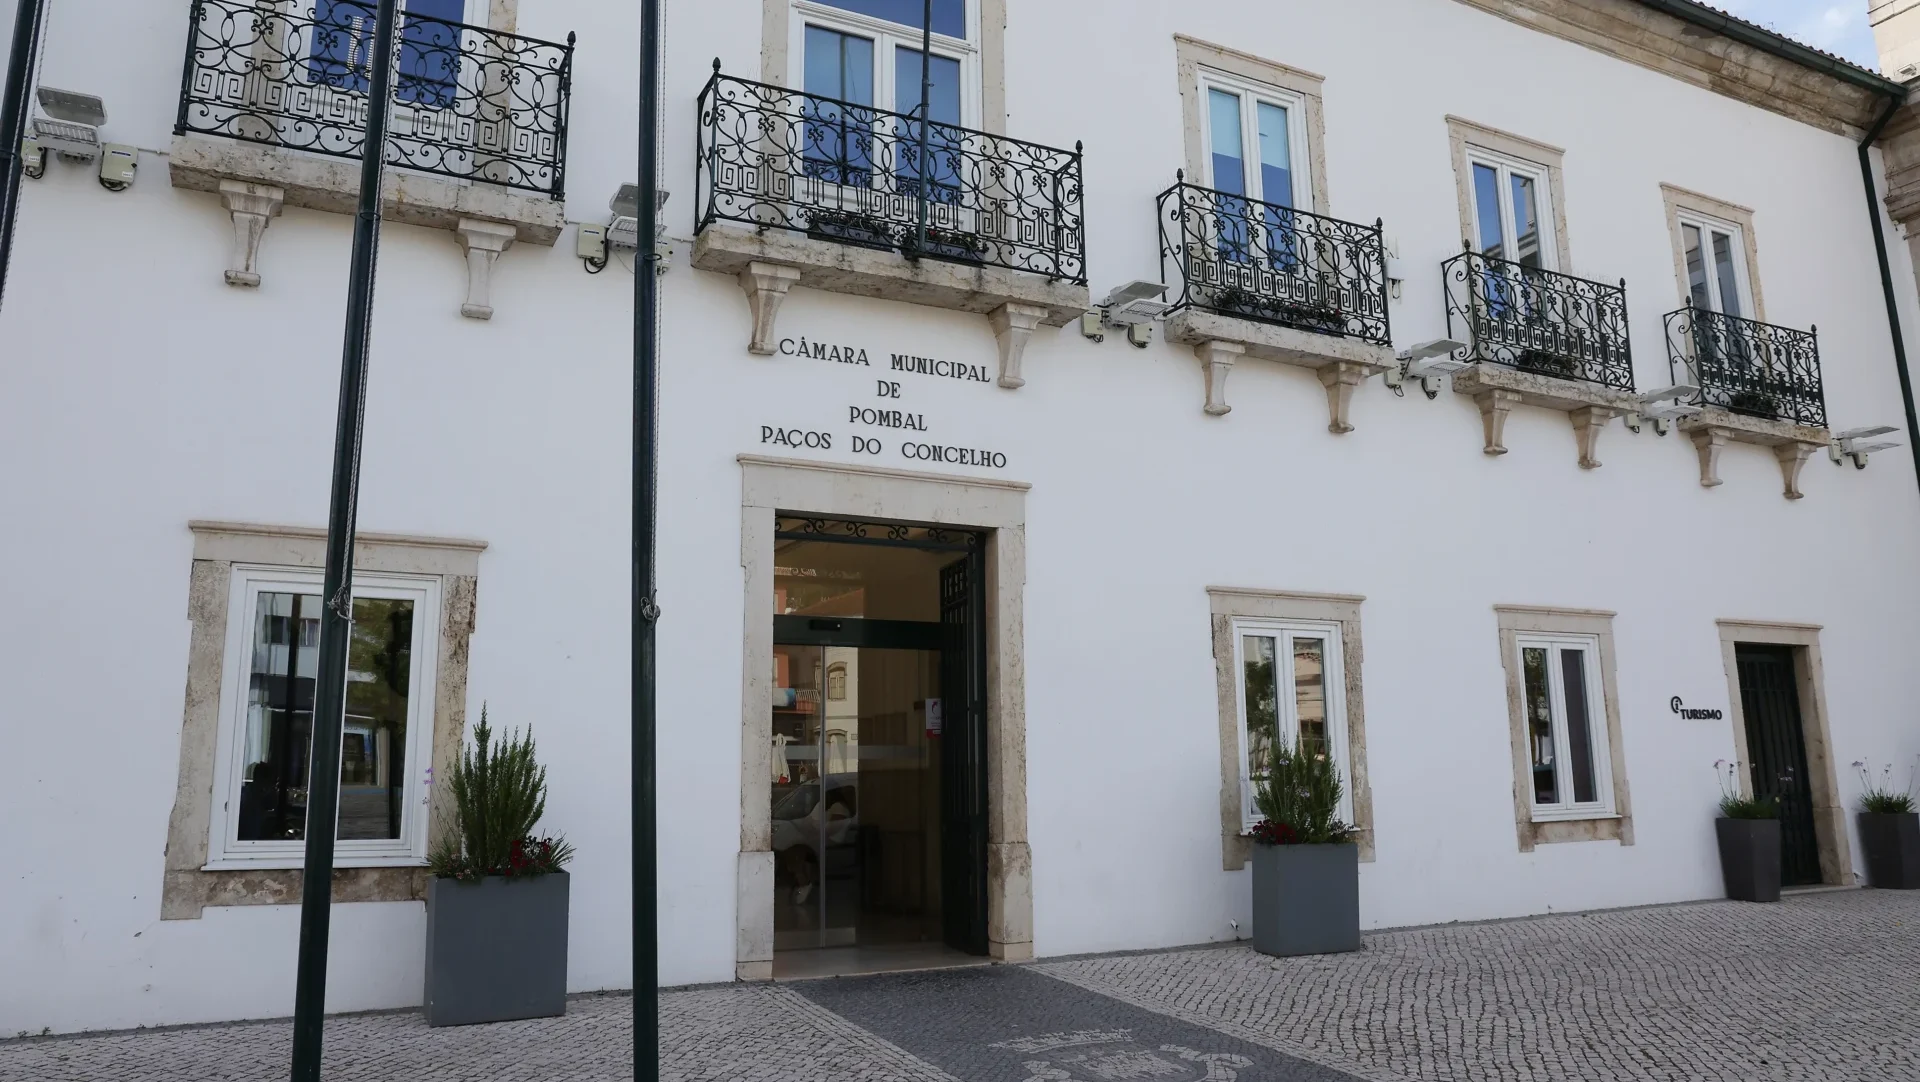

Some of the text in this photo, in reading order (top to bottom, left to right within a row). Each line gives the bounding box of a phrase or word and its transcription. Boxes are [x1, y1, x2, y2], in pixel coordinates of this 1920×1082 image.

[779, 336, 991, 383] CÂMARA MUNICIPAL
[876, 380, 901, 399] DE
[849, 406, 928, 432] POMBAL
[760, 425, 1007, 469] PAÇOS DO CONCELHO
[1680, 708, 1723, 721] TURISMO
